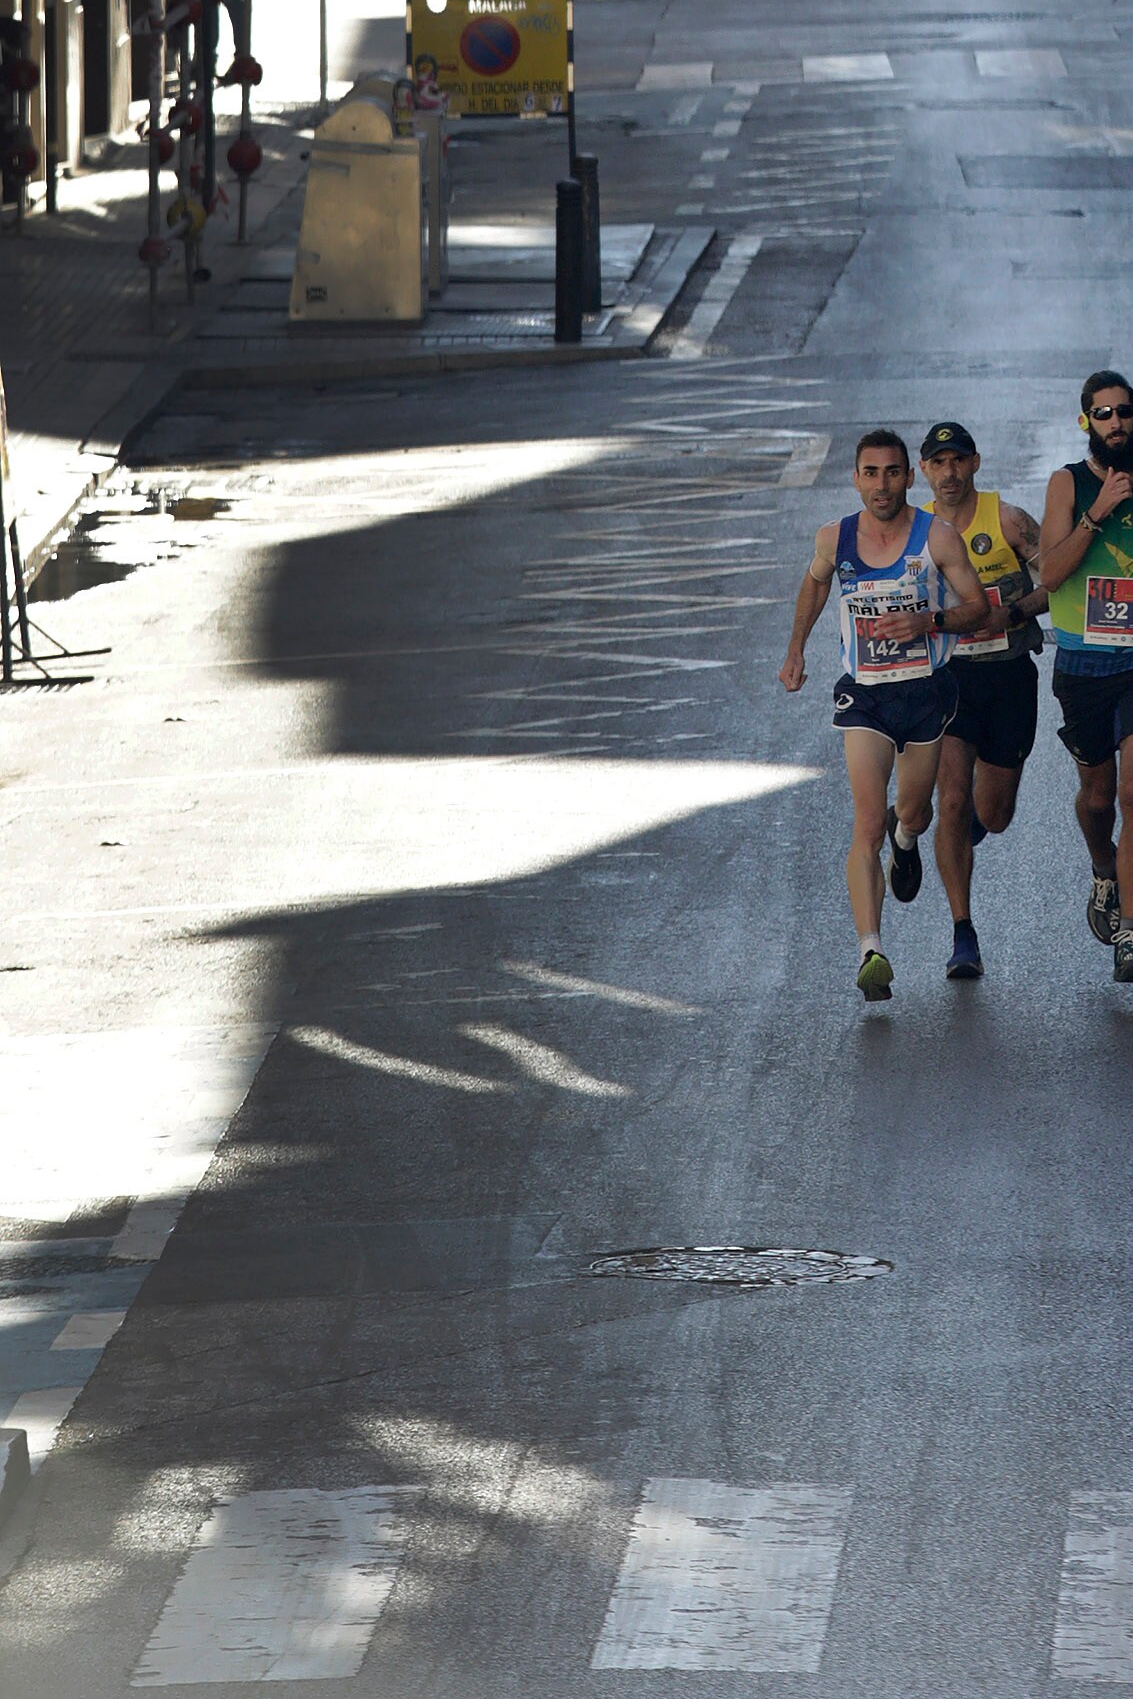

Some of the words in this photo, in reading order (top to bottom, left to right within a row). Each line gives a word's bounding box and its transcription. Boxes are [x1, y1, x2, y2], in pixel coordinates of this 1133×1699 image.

[852, 594, 914, 603] ATLETISMO
[1104, 601, 1129, 619] 32
[867, 639, 900, 657] 142
